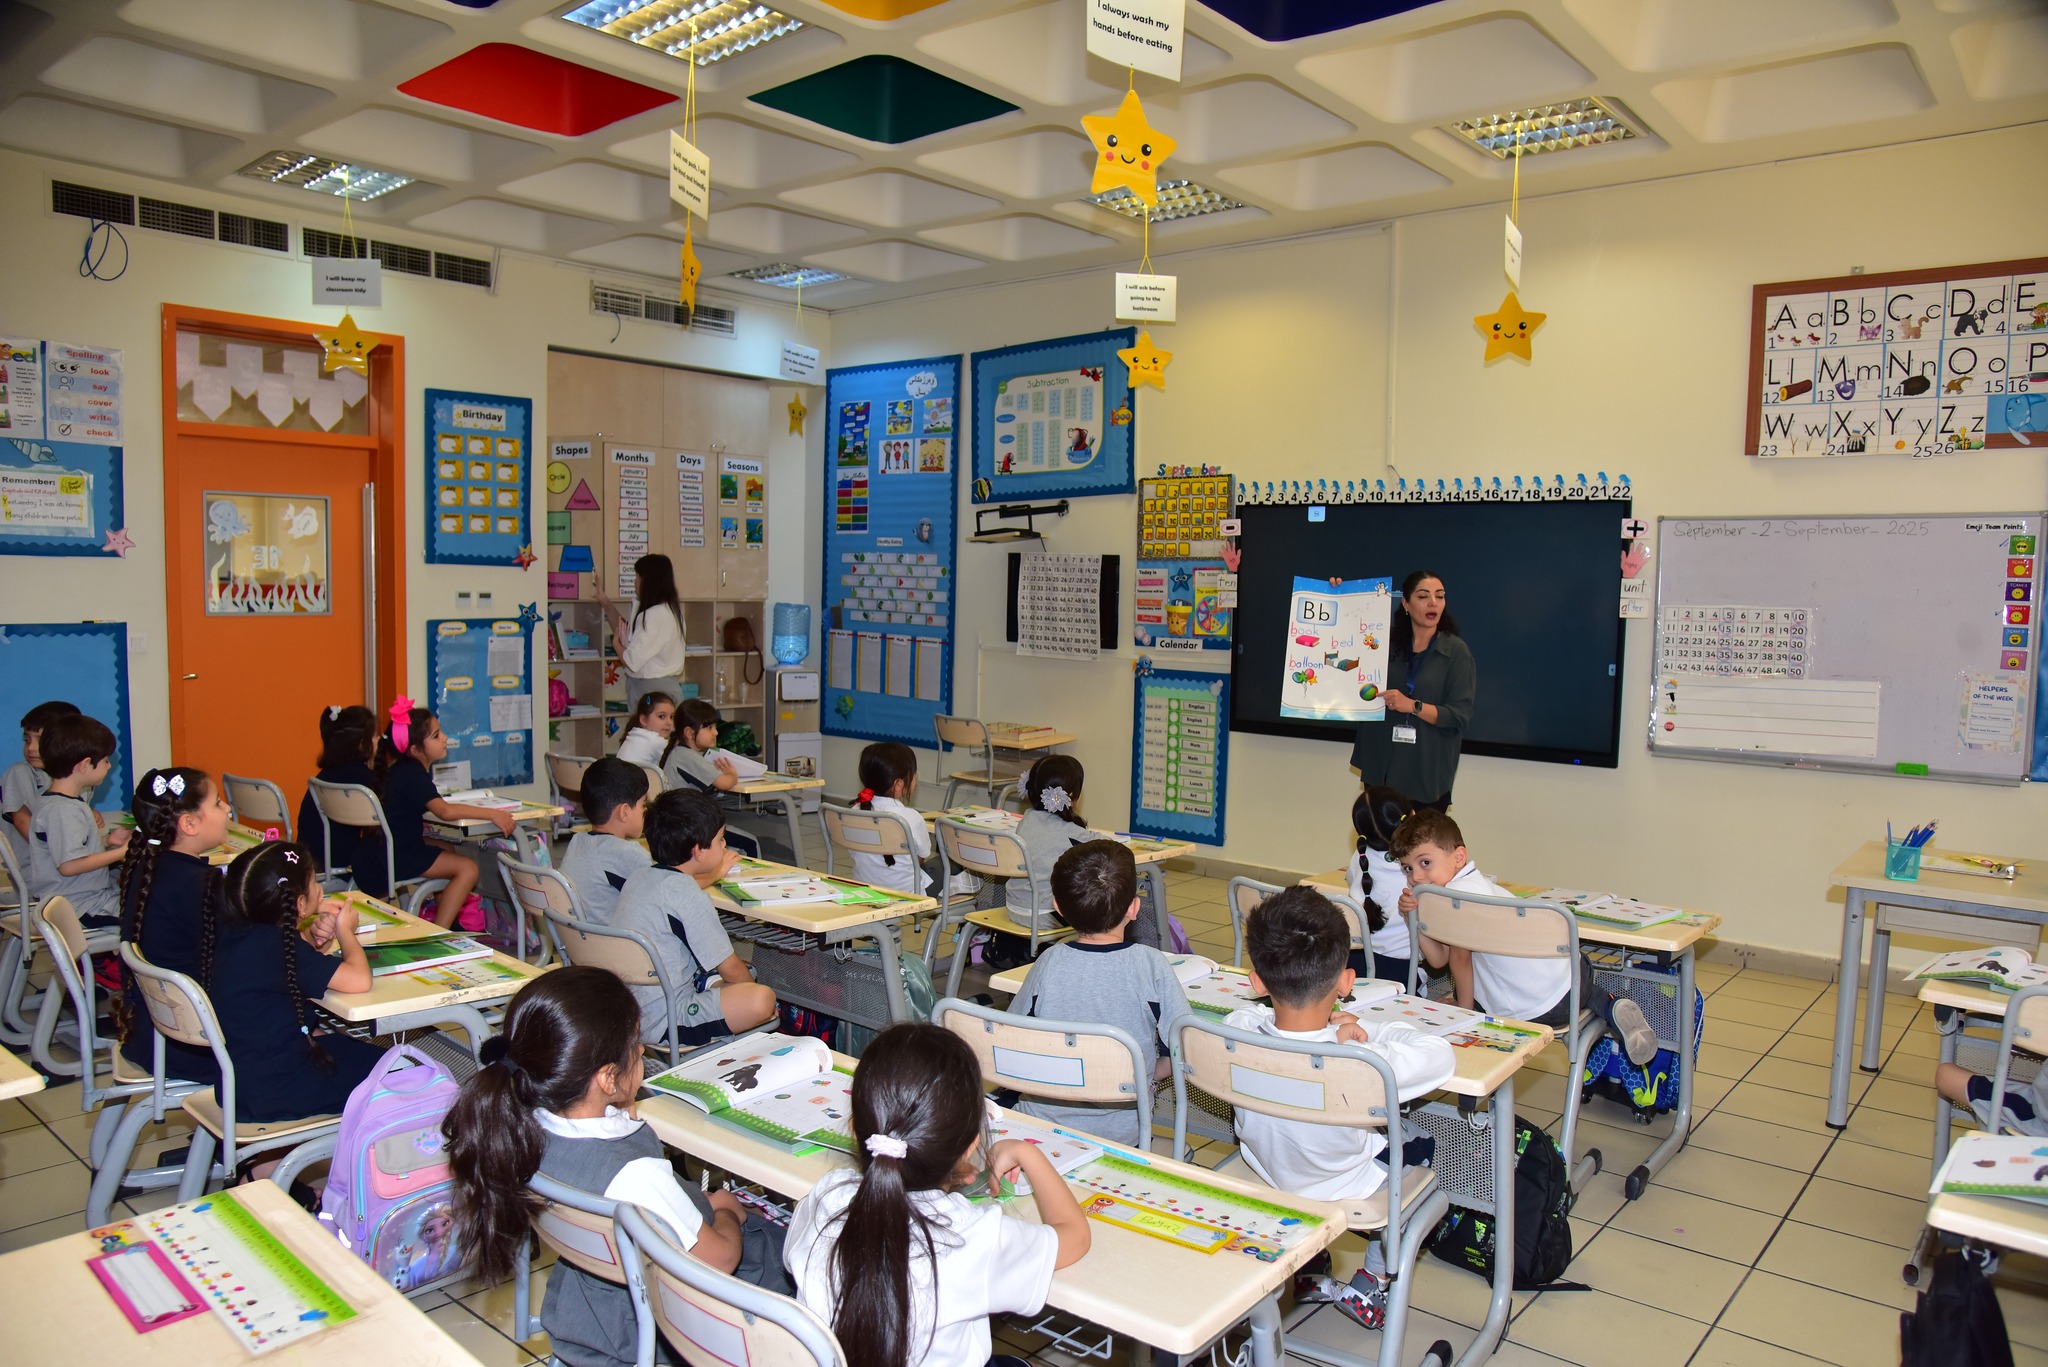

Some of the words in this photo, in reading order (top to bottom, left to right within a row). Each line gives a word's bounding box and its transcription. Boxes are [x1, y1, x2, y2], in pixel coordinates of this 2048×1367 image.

[1102, 2, 1130, 19] always
[1132, 13, 1154, 26] wash
[1156, 21, 1170, 31] my
[1093, 18, 1115, 35] hands
[1117, 28, 1144, 43] before
[1146, 39, 1173, 53] eating
[1995, 321, 2006, 334] 4
[1829, 332, 1838, 345] 2
[1886, 329, 1894, 342] 3
[1768, 337, 1776, 349] 1
[65, 349, 104, 362] Spelling
[90, 367, 110, 376] look
[92, 384, 108, 392] say
[1027, 377, 1070, 388] Subtraction
[1983, 379, 2004, 393] 15
[2008, 379, 2029, 393] 16
[1763, 391, 1780, 405] 12
[1816, 389, 1835, 402] 13
[1883, 385, 1901, 398] 14
[88, 399, 112, 407] cover
[89, 413, 112, 421] write
[462, 409, 503, 422] Birthday
[86, 428, 113, 437] check
[555, 446, 588, 456] Shapes
[1760, 445, 1778, 457] 23
[1827, 443, 1846, 456] 24
[1912, 445, 1933, 458] 25
[1934, 442, 1954, 455] 26
[615, 452, 649, 463] Months
[680, 455, 701, 466] Days
[727, 460, 759, 471] Seasons
[1157, 463, 1221, 477] September
[1, 476, 56, 485] Remember:
[621, 478, 646, 486] February
[1237, 494, 1244, 503] 0
[1252, 494, 1257, 503] 1
[1265, 493, 1271, 501] 2
[1278, 493, 1284, 501] 3
[1291, 492, 1297, 502] 4
[1303, 492, 1309, 502] 5
[1317, 492, 1324, 501] 6
[1331, 493, 1338, 502] 7
[1345, 493, 1351, 501] 8
[1357, 492, 1364, 500] 9
[1369, 491, 1383, 501] 10
[1389, 491, 1402, 500] 11
[1408, 491, 1423, 501] 12
[1428, 490, 1442, 501] 13
[1446, 491, 1460, 501] 14
[1465, 489, 1479, 499] 15
[1484, 489, 1499, 499] 16
[1504, 489, 1519, 500] 17
[1525, 489, 1540, 500] 18
[1546, 487, 1562, 498] 19
[1568, 487, 1584, 498] 20
[1590, 485, 1607, 498] 21
[1612, 486, 1631, 499] 22
[1673, 520, 1746, 539] September
[1886, 520, 1930, 535] 2025
[1966, 524, 1982, 532] Emoji
[1218, 576, 1237, 588] ten
[1624, 579, 1647, 593] unit
[1621, 600, 1644, 612] after
[1290, 621, 1319, 636] book
[1359, 618, 1384, 632] bee
[1680, 624, 1690, 632] 12
[1722, 625, 1732, 633] 15
[1736, 625, 1746, 633] 16
[1765, 626, 1775, 634] 18
[1792, 627, 1804, 635] 20
[1159, 640, 1198, 650] Calendar
[1331, 635, 1354, 648] bed
[1289, 654, 1324, 669] balloon
[1357, 668, 1382, 682] ball
[1979, 685, 2008, 693] HELPERS
